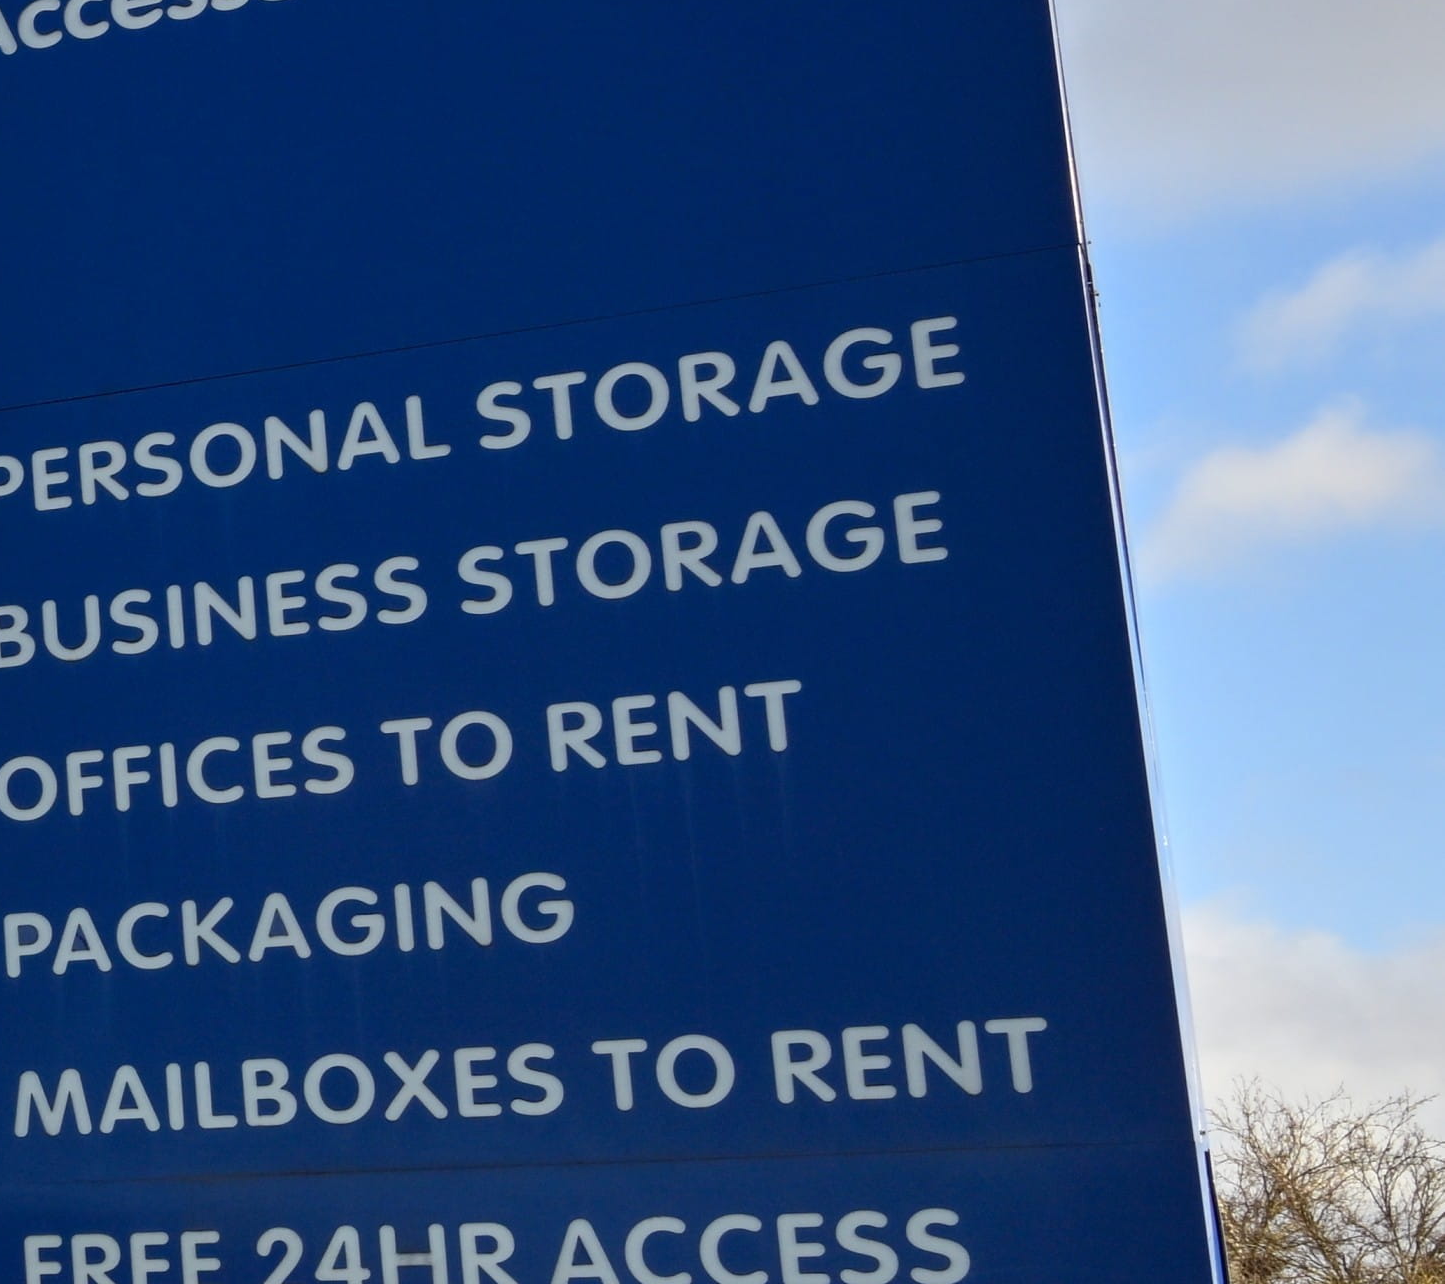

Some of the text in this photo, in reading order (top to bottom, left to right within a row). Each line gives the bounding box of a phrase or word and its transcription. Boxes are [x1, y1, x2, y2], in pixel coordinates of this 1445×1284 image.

[477, 315, 967, 452] STORAGE
[457, 490, 950, 616] STORAGE
[381, 711, 513, 787] TO
[546, 679, 802, 772] RENT
[3, 871, 575, 979] PACKAGING
[13, 1017, 1048, 1138] MAILBOXES TO RENT
